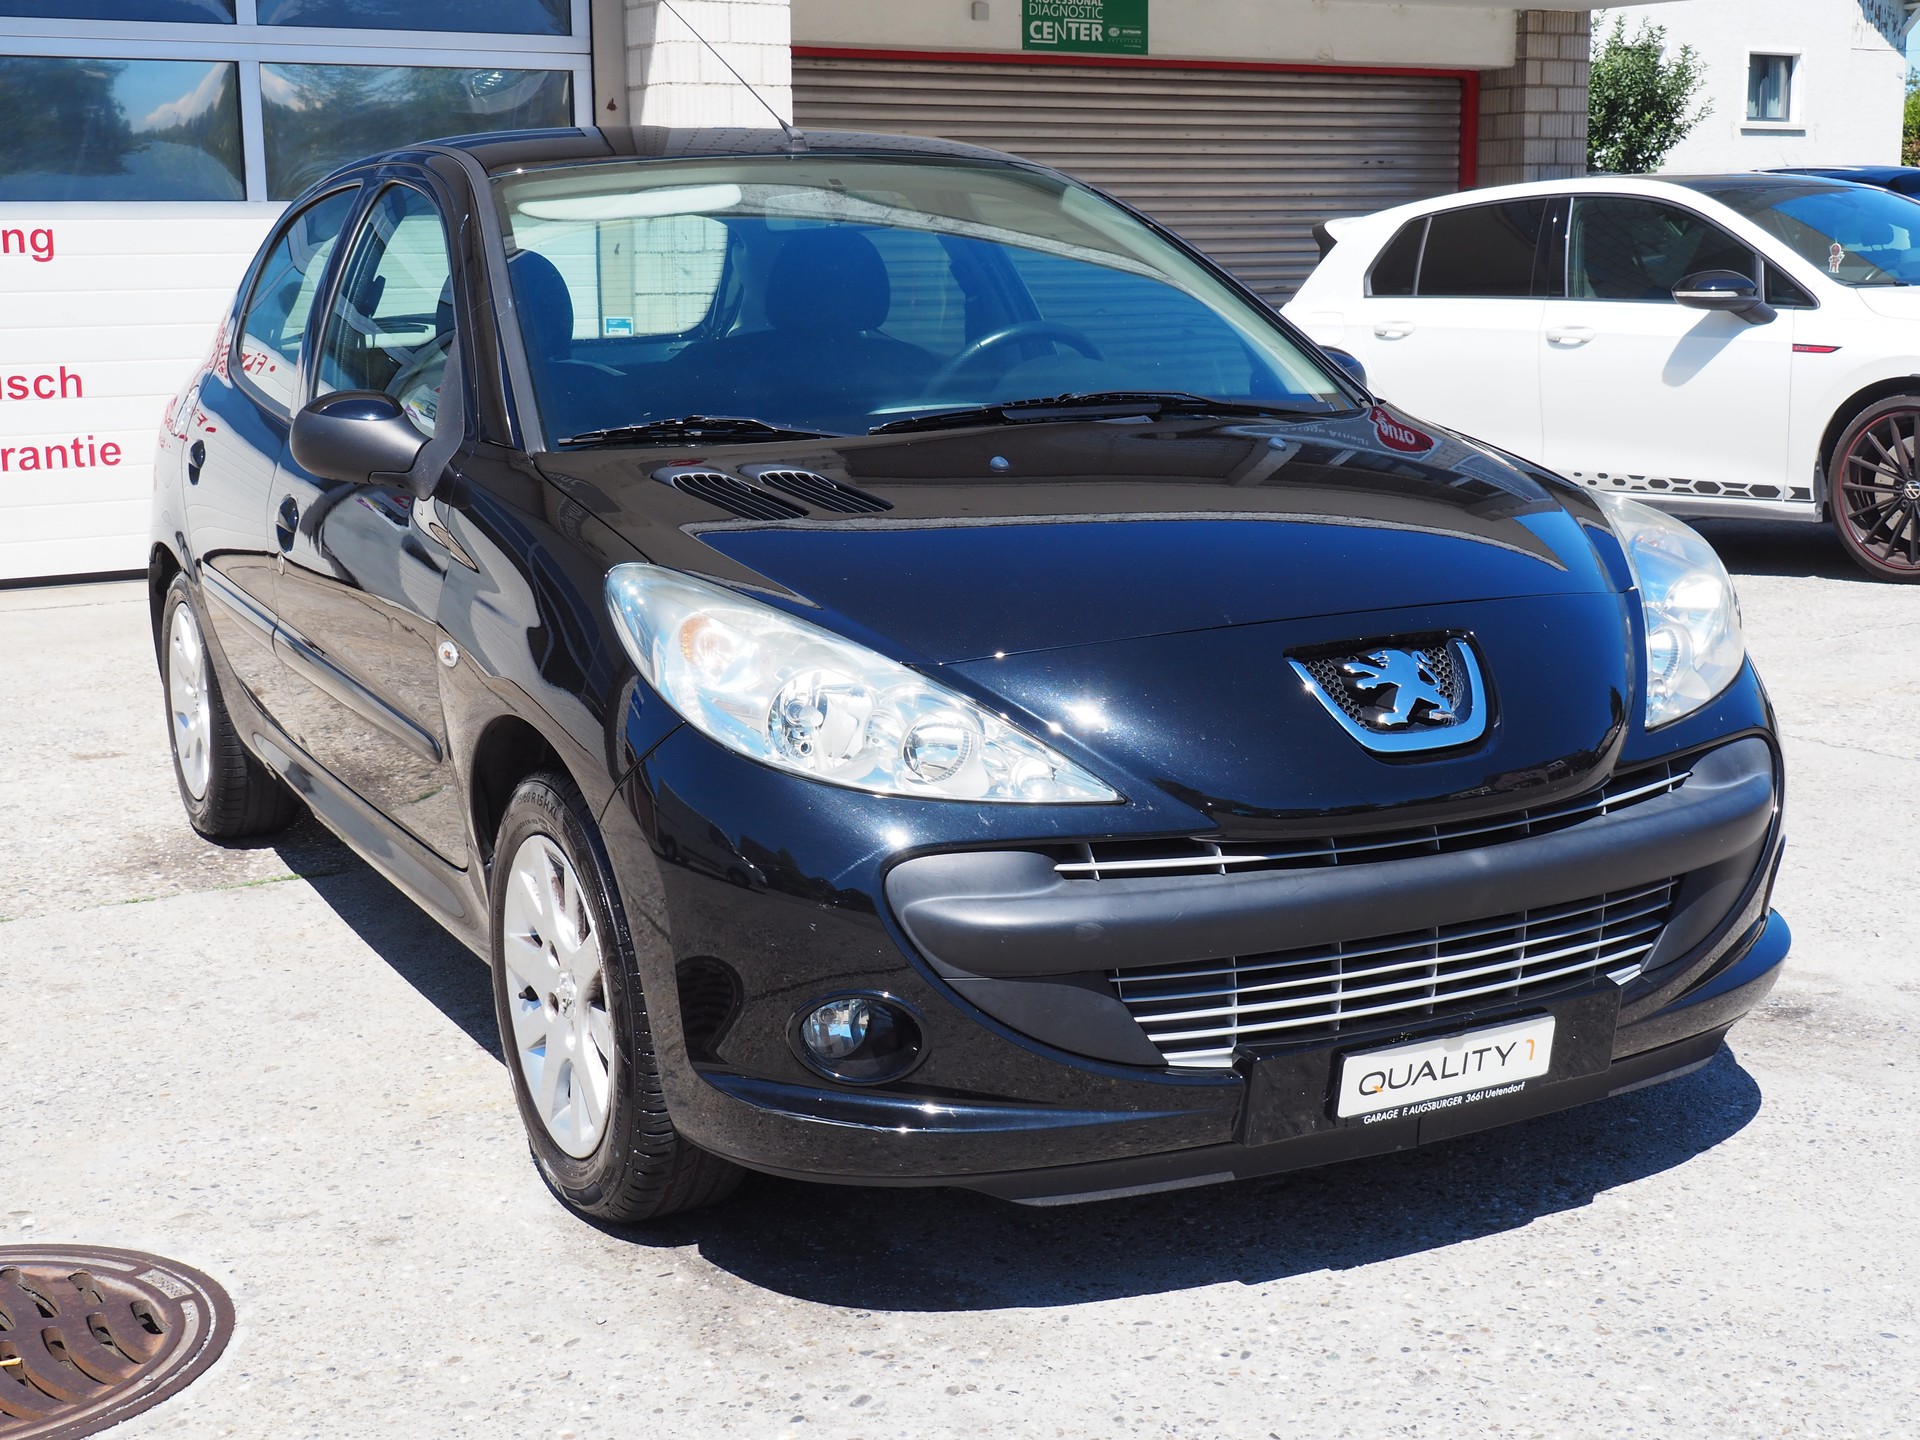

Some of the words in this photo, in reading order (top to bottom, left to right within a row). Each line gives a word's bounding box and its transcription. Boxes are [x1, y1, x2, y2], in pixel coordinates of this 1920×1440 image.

[1029, 3, 1103, 19] DIAGNOSTIC
[1029, 18, 1104, 43] CENTER
[1, 228, 55, 263] ng
[0, 366, 83, 400] sch
[0, 435, 122, 472] rantie
[1358, 1041, 1517, 1096] QUALITY
[1525, 1038, 1536, 1061] 1
[1363, 1108, 1399, 1125] GARAGE
[1465, 1091, 1484, 1103] 3661
[1485, 1081, 1526, 1099] Uetendorf
